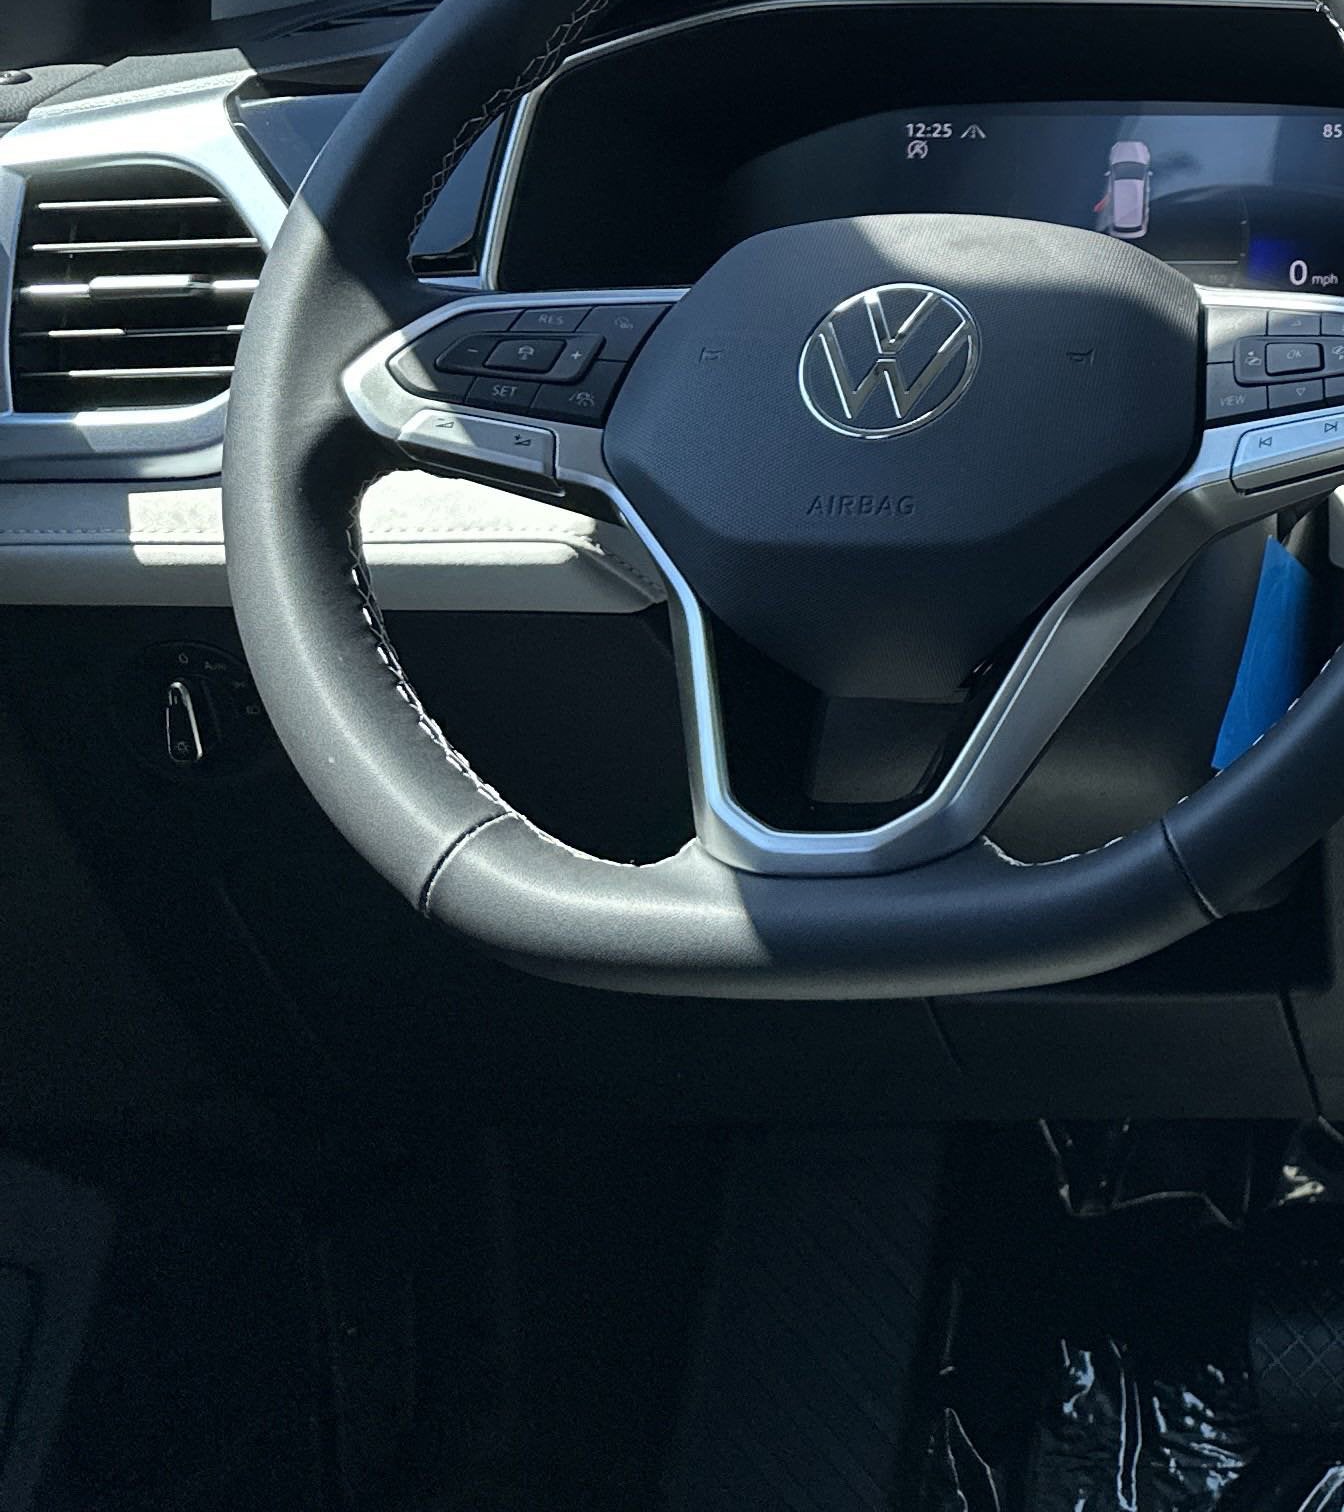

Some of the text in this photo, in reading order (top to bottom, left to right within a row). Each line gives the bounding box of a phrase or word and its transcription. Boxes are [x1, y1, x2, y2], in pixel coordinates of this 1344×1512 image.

[905, 122, 953, 139] 12:25
[1289, 259, 1339, 287] 0 mph
[490, 384, 517, 398] SET
[1219, 393, 1247, 408] VIEW
[805, 494, 916, 519] AIRBAG
